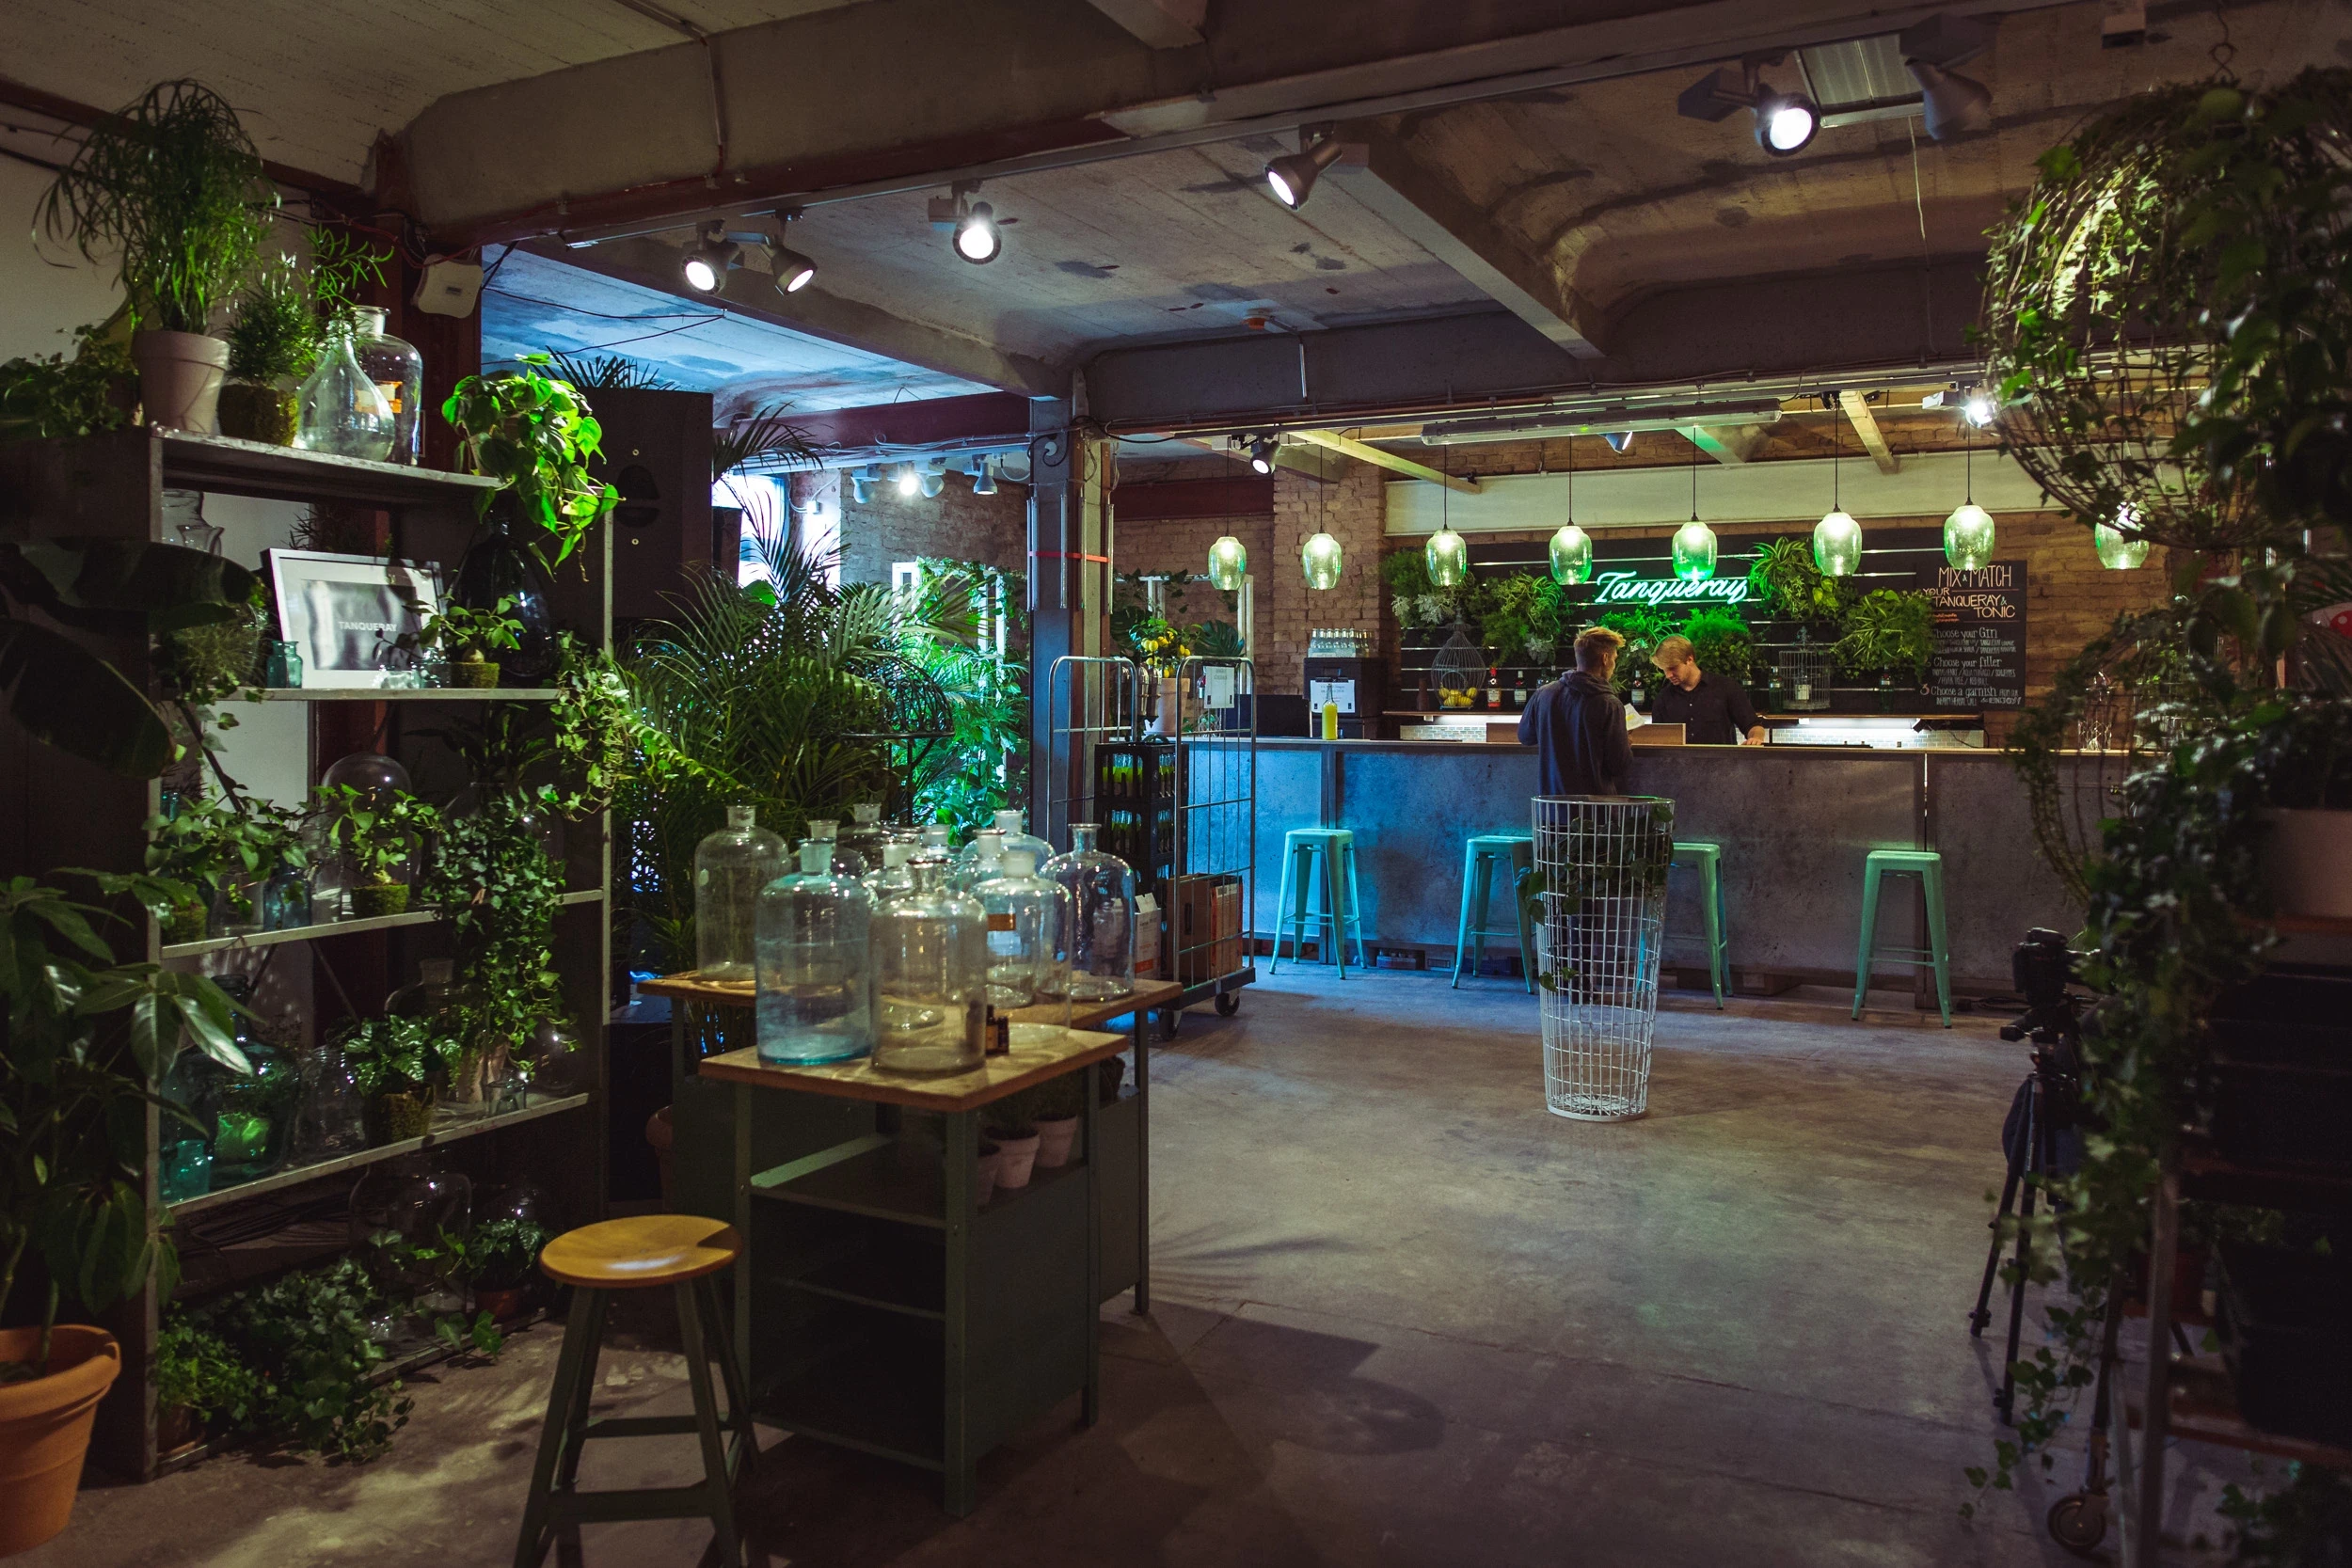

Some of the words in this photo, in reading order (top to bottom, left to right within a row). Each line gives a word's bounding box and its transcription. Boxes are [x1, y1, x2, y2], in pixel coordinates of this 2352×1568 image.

[1938, 567, 1963, 588] MIX
[1969, 565, 2011, 588] MATCH
[1595, 570, 1748, 607] Tanqueray
[1923, 588, 1950, 596] YOUR
[1932, 594, 2001, 608] TANQUERAY
[1974, 605, 2016, 618] TONIC
[338, 621, 398, 632] TANQUERAY
[1960, 631, 1979, 641] your
[1979, 627, 1997, 639] Gin
[1933, 657, 1960, 667] Choose
[1961, 660, 1978, 669] your
[1979, 656, 2003, 669] filler
[1931, 686, 1957, 695] Choose
[1965, 686, 1997, 698] garnish
